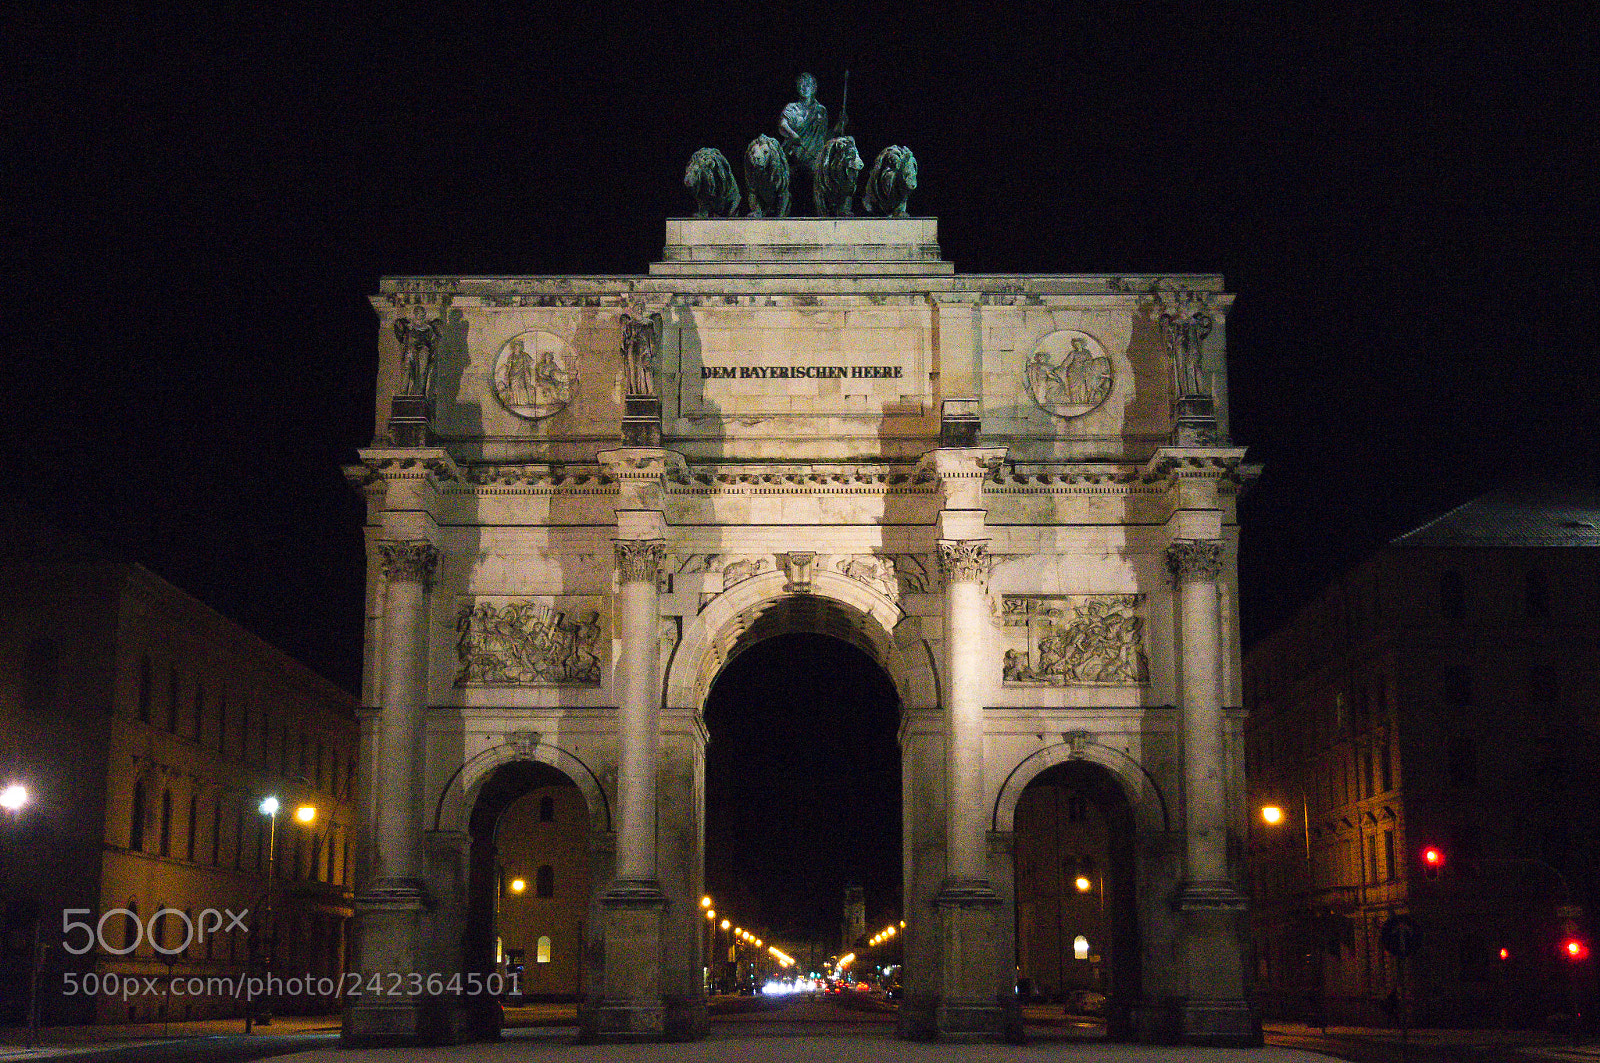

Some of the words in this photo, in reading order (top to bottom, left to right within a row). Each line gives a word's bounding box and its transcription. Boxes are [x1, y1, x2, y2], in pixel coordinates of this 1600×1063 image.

[701, 366, 737, 379] DEM
[740, 366, 848, 379] BAYERISCHEN
[851, 366, 903, 379] HEERE
